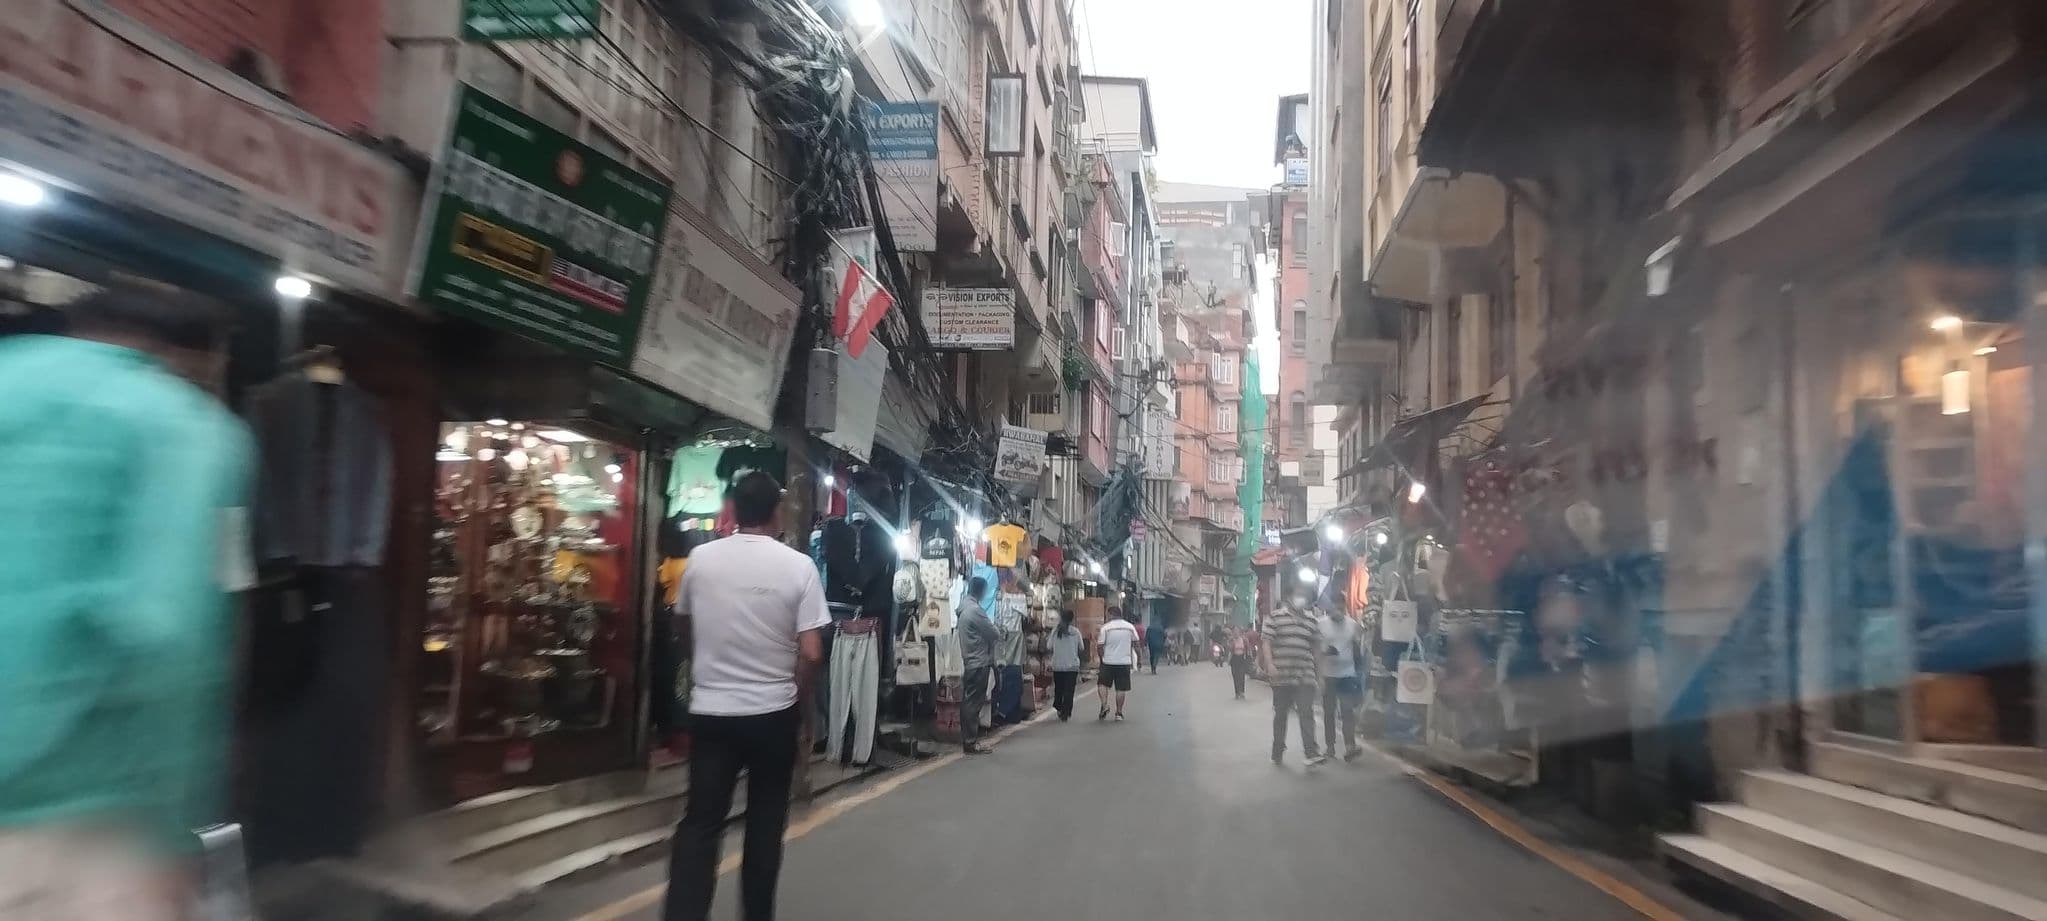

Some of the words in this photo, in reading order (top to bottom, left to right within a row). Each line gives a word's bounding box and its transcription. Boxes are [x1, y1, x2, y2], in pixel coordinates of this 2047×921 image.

[879, 113, 934, 129] EXPORTS
[948, 293, 974, 302] VISION
[976, 293, 1010, 302] EXPORTS
